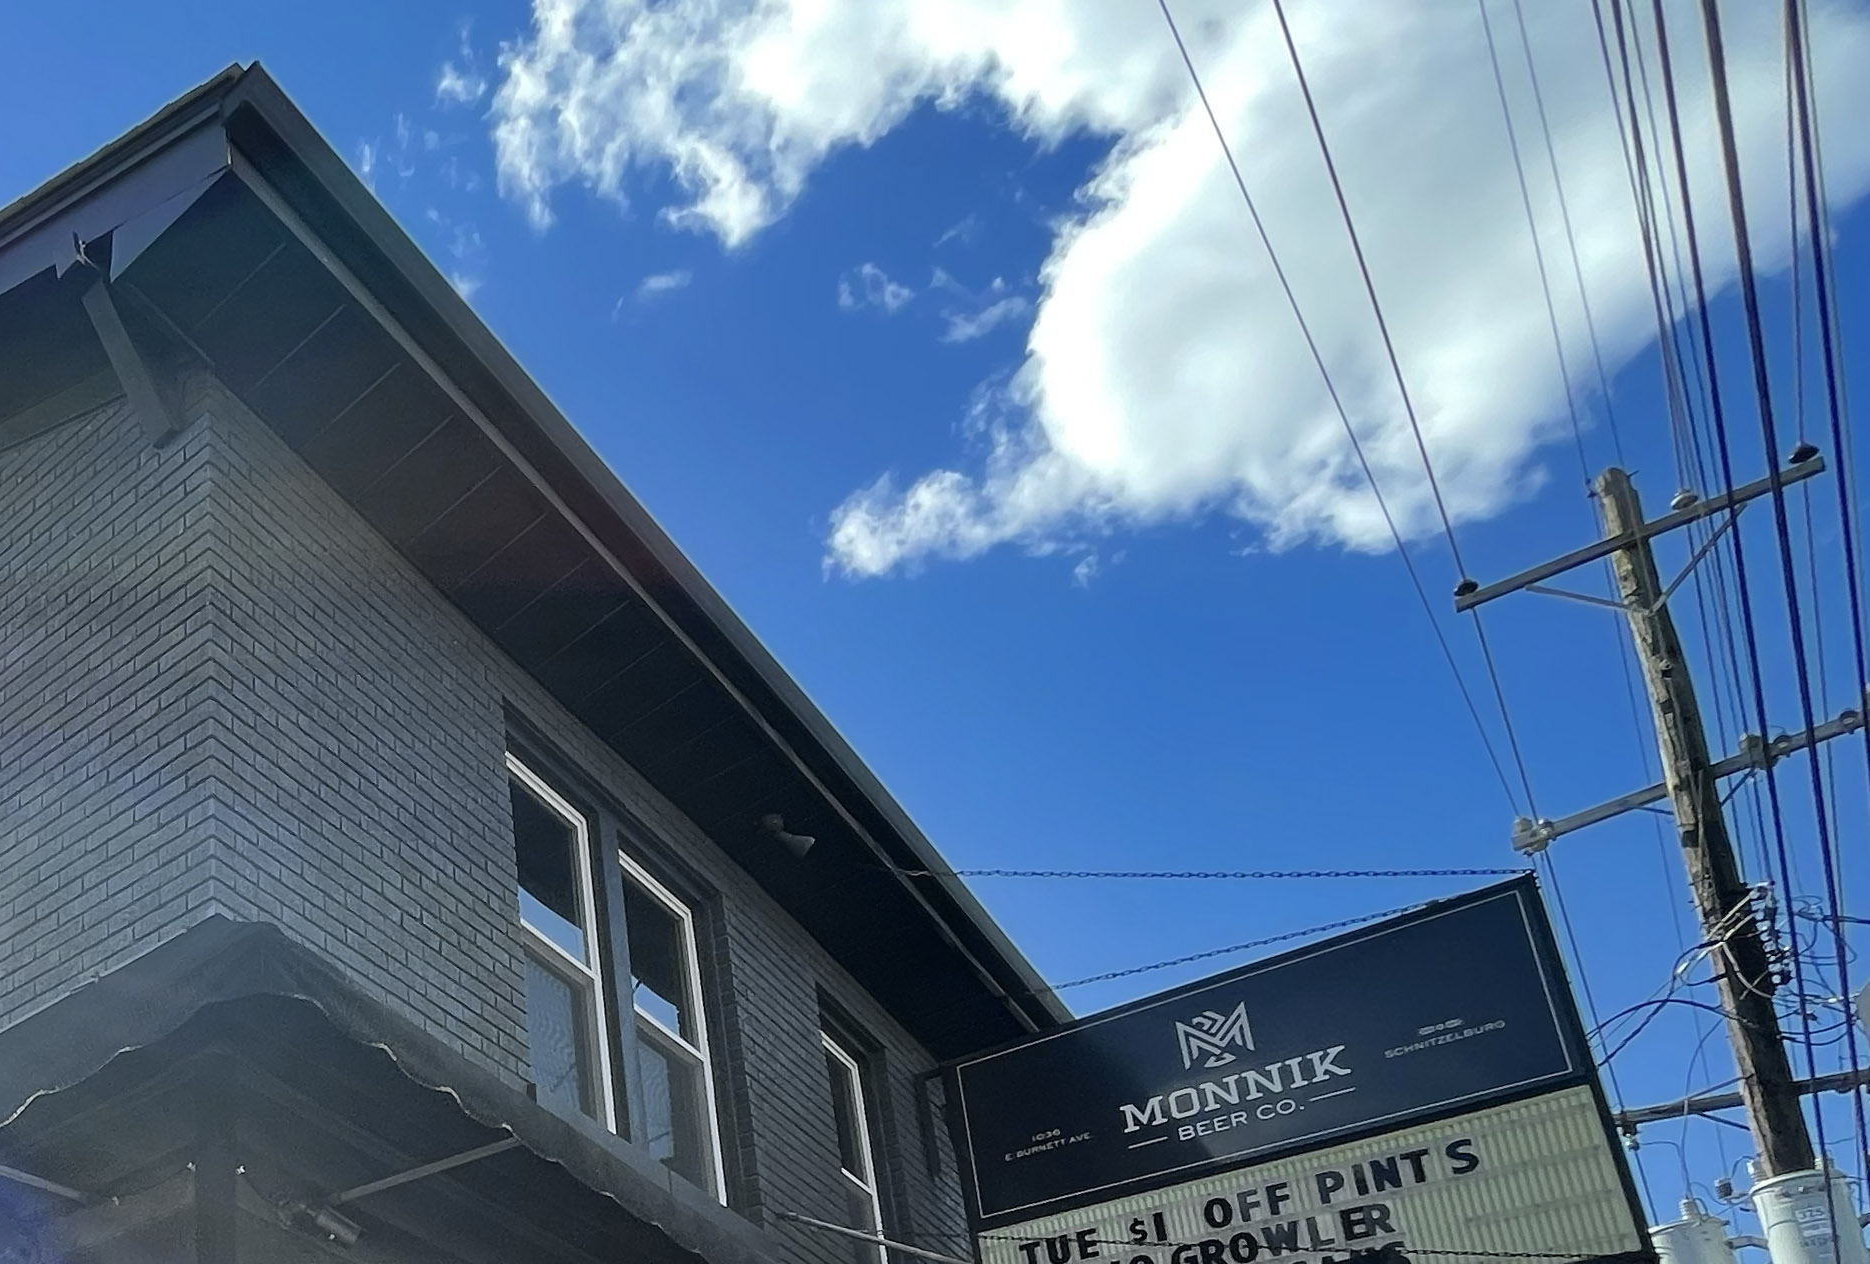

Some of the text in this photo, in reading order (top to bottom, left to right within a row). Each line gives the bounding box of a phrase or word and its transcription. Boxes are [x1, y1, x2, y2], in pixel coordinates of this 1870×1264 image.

[1384, 1020, 1506, 1058] SCHNITZELBURG
[1119, 1045, 1352, 1134] MONNIK
[1178, 1099, 1305, 1141] BEER CO.
[1129, 1211, 1169, 1244] $1
[1204, 1182, 1290, 1229] OFF
